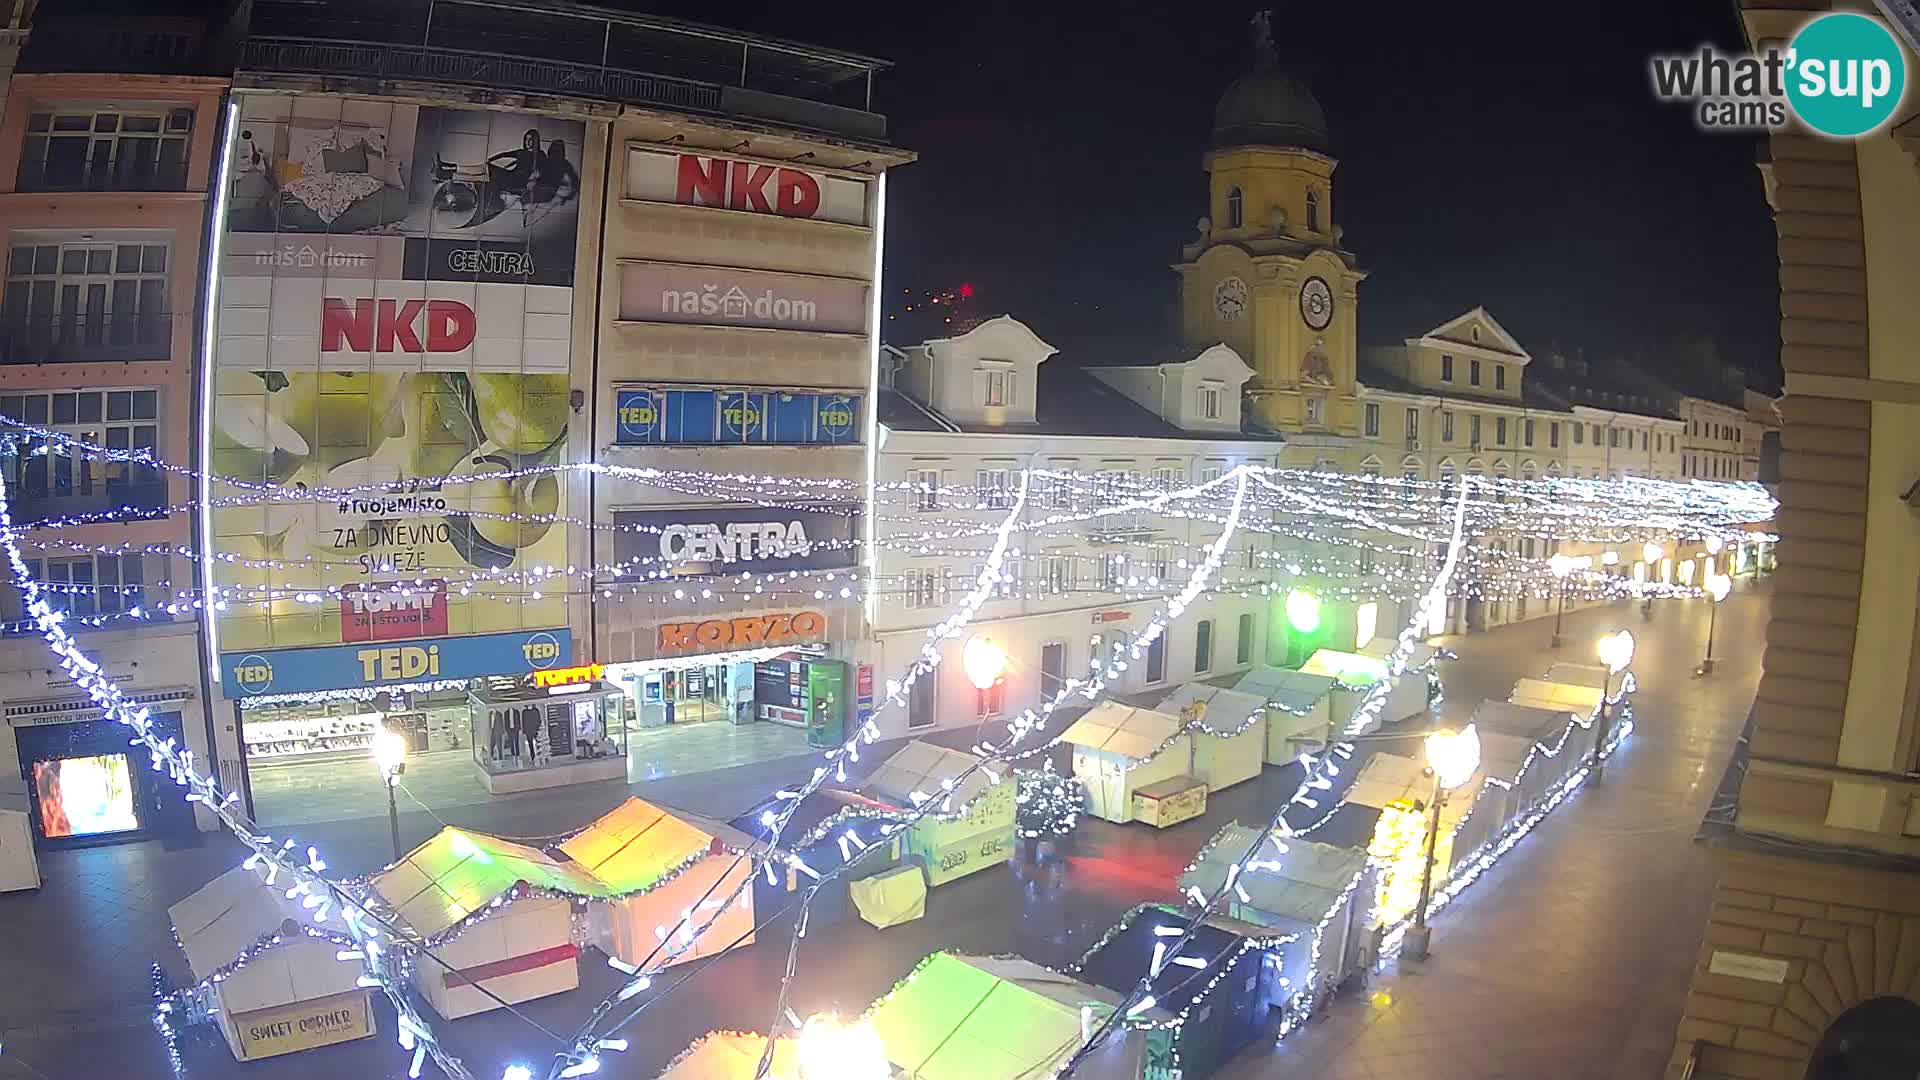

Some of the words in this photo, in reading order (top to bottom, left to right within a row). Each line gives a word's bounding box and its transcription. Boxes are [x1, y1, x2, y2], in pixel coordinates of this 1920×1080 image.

[675, 153, 821, 219] NKD
[254, 244, 295, 267] naš
[319, 244, 370, 268] dom
[447, 248, 535, 275] CENTRA
[661, 283, 718, 316] naš
[754, 289, 817, 321] dom
[321, 296, 477, 353] NKD
[619, 407, 658, 425] TEDi
[723, 408, 760, 425] TEDi
[820, 410, 852, 426] TEDi
[333, 528, 358, 549] ZA
[368, 523, 450, 547] DNEVNO
[659, 520, 810, 562] CENTRA
[659, 611, 825, 650] KORZO
[357, 644, 440, 683] TEDi
[522, 641, 560, 662] TEDi
[233, 665, 274, 684] TEDi
[250, 1021, 293, 1041] SWEET
